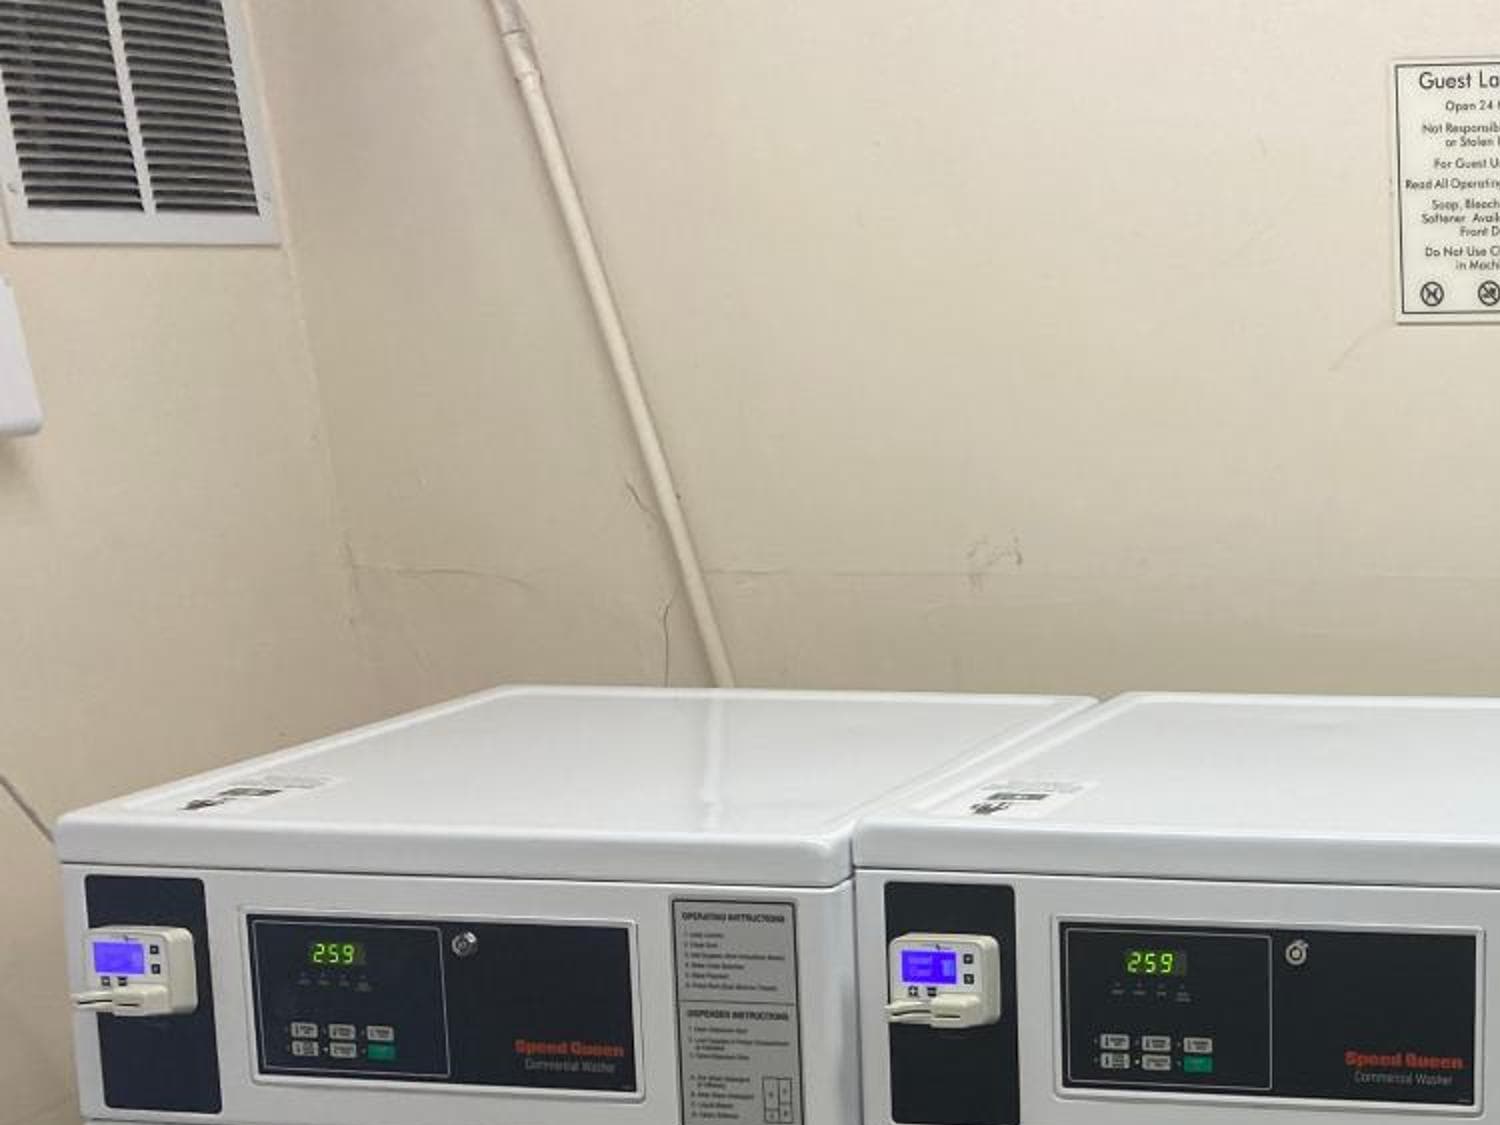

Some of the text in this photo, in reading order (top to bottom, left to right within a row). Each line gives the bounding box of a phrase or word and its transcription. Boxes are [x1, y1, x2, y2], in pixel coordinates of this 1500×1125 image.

[1419, 71, 1471, 90] Guest
[1445, 100, 1476, 113] Open
[1479, 100, 1493, 110] 24
[1422, 122, 1443, 133] Not
[1445, 138, 1457, 147] or
[1460, 136, 1494, 147] Stolen
[1433, 158, 1452, 169] For
[1455, 158, 1487, 169] Guest
[1405, 179, 1433, 190] Read
[1434, 178, 1449, 188] All
[1465, 198, 1500, 209] Bleach
[1459, 226, 1489, 237] Front
[1425, 247, 1441, 257] Do
[1443, 246, 1464, 257] Not
[1466, 246, 1487, 257] Use
[1456, 260, 1467, 270] in
[313, 943, 354, 963] 259
[1127, 951, 1173, 973] 259
[514, 1039, 625, 1057] Speed Queen
[1344, 1051, 1463, 1069] Speed Queen
